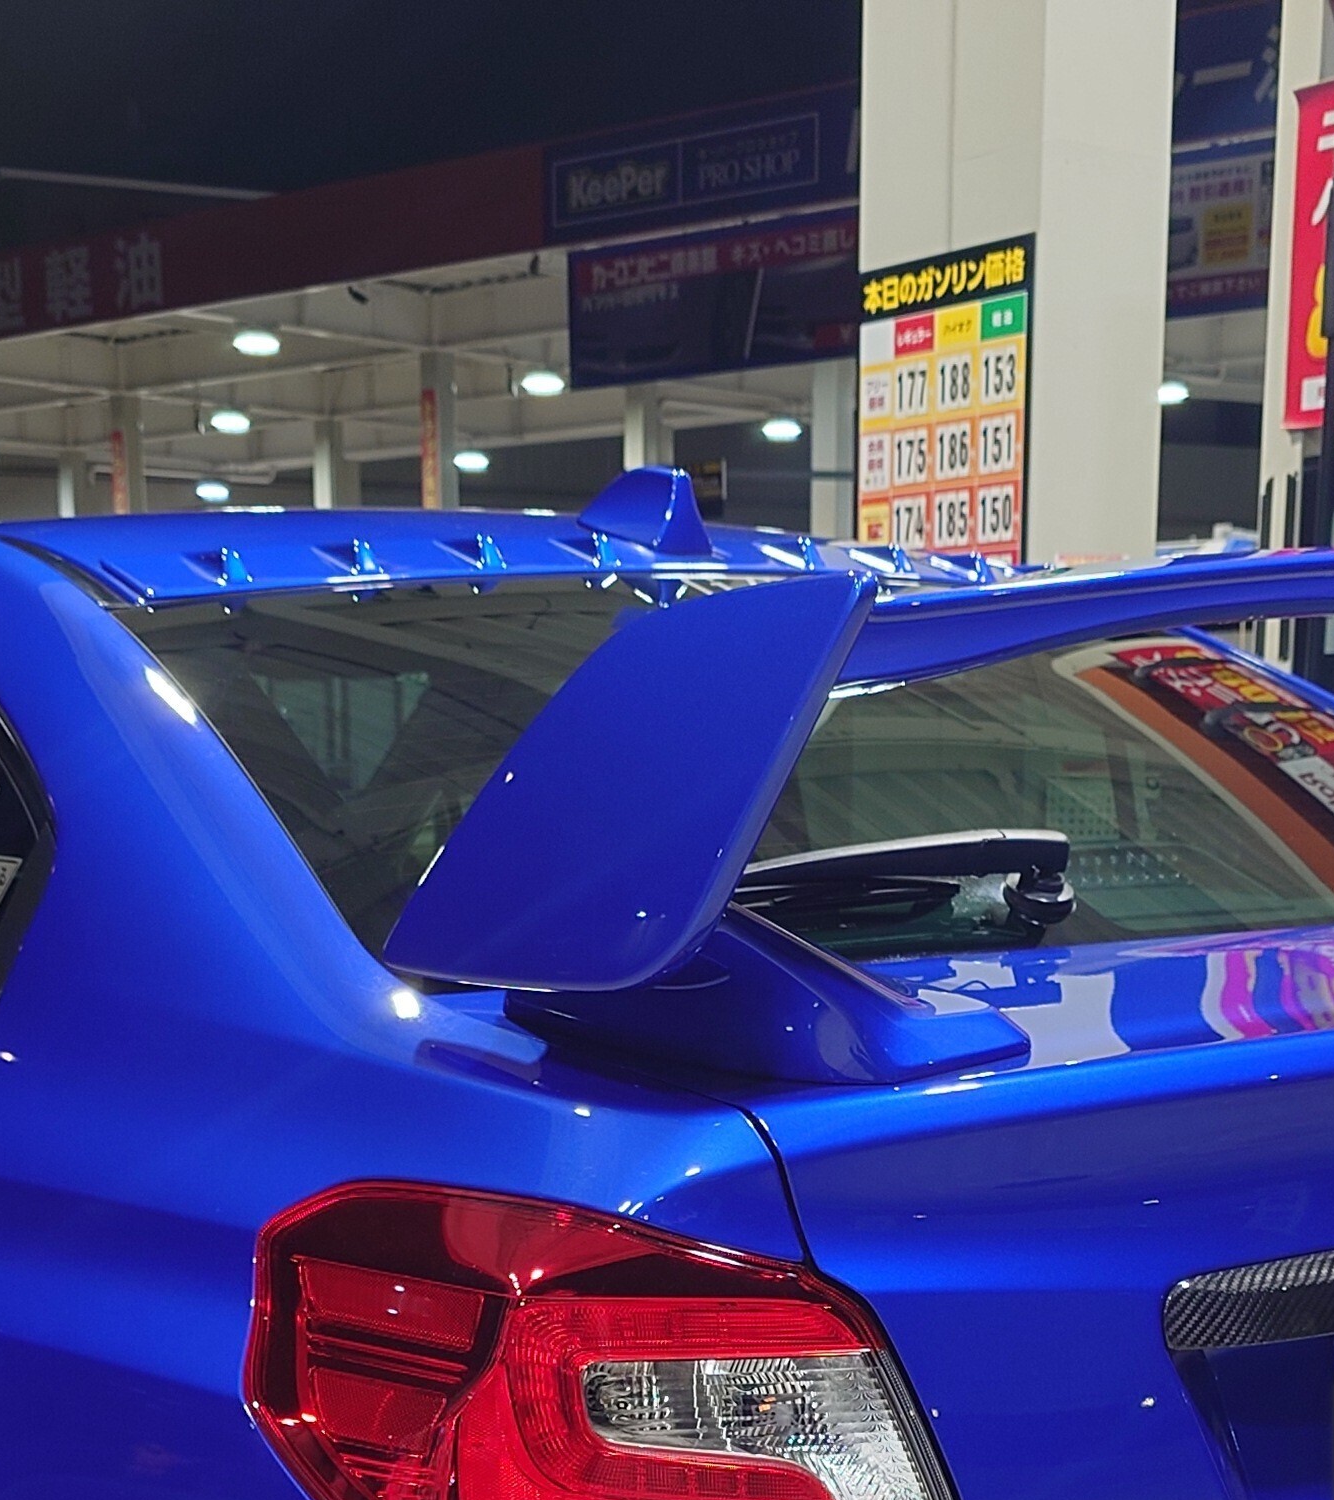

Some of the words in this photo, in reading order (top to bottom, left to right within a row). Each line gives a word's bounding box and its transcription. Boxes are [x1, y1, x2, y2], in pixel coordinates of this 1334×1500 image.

[570, 165, 666, 208] KeePer
[862, 246, 1026, 314] 本日のガソリン価格
[897, 370, 928, 412] 177
[939, 362, 971, 406] 188
[983, 352, 1016, 398] 153
[895, 437, 927, 479] 175
[938, 430, 968, 473] 186
[981, 422, 1013, 465] 151
[936, 499, 968, 542] 185
[980, 493, 1012, 535] 150
